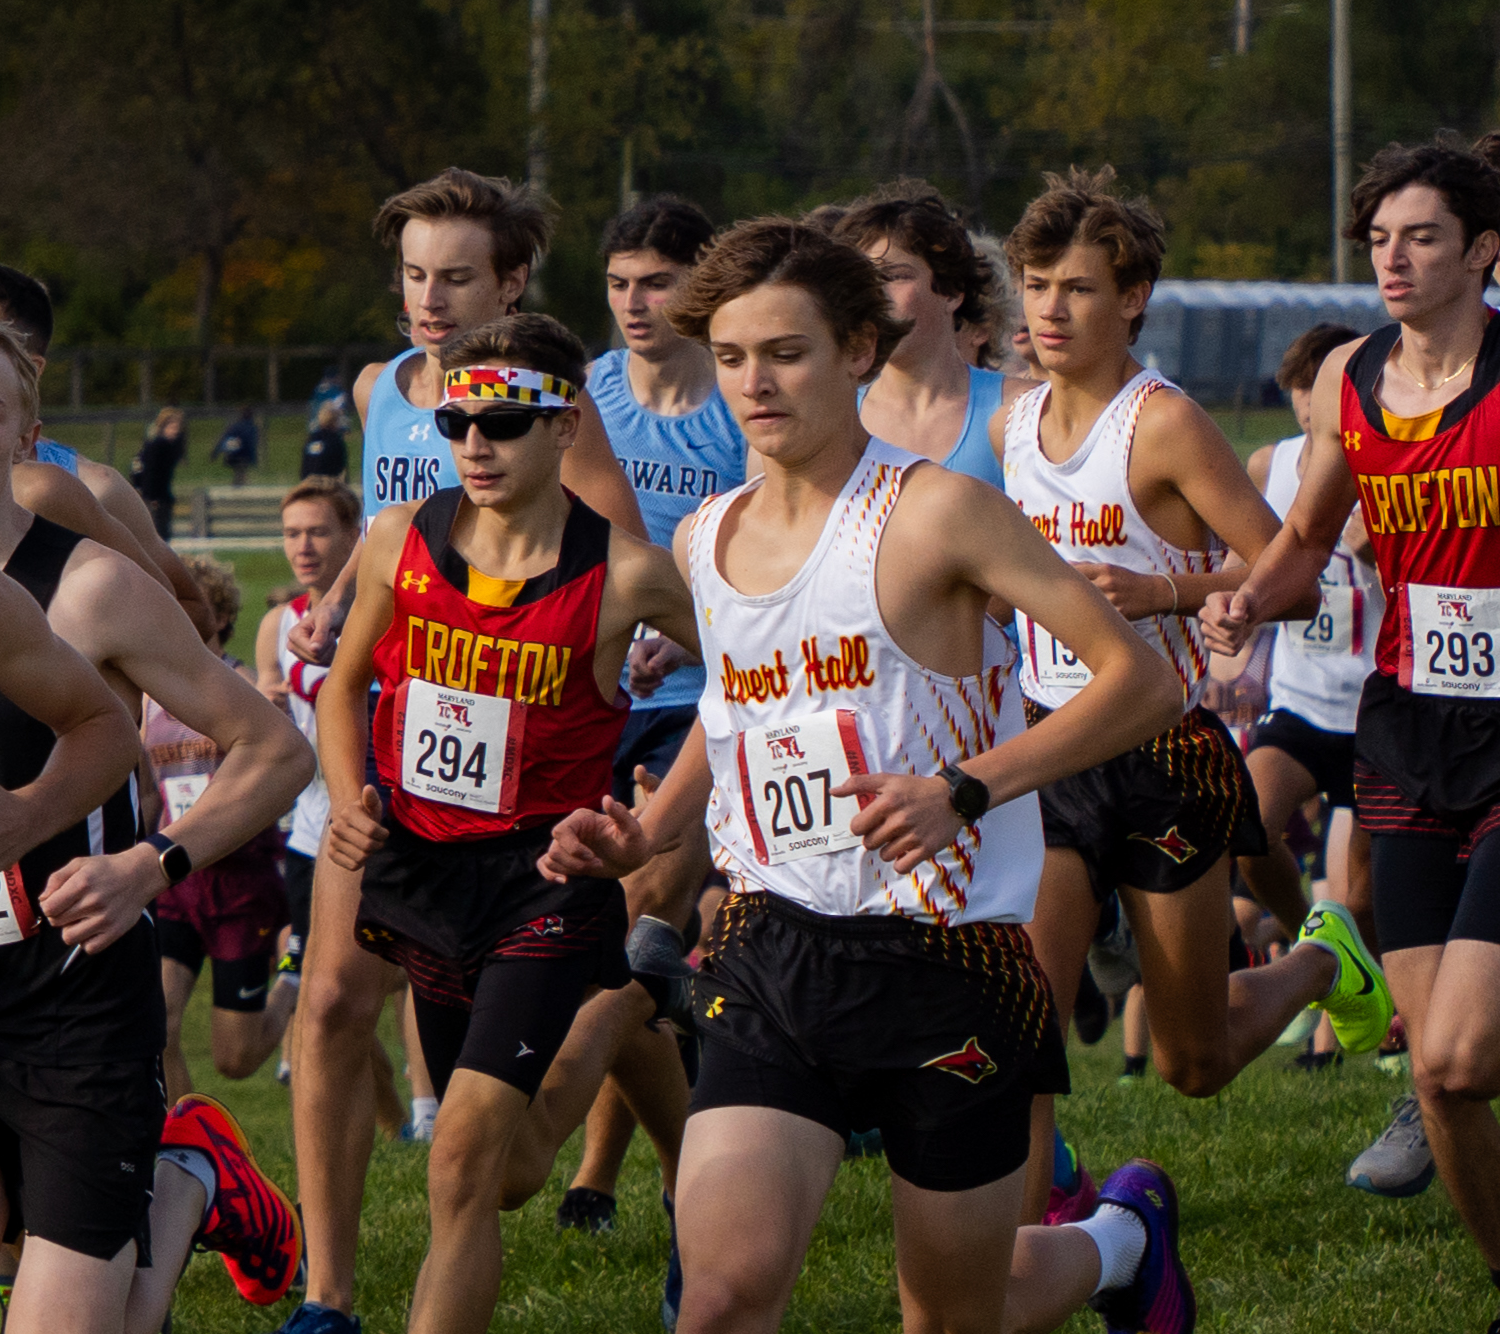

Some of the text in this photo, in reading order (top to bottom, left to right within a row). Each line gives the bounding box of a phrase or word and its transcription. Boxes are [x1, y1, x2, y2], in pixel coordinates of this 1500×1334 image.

[375, 455, 441, 502] SRHS
[618, 457, 719, 499] WARD
[1358, 465, 1500, 534] CROFTON
[1069, 500, 1128, 548] Hall
[406, 615, 572, 707] CROFTON
[801, 634, 876, 698] Hall
[1426, 629, 1496, 678] 293
[1441, 680, 1481, 692] saucony
[415, 728, 488, 789] 294
[425, 783, 467, 800] saucony
[763, 768, 832, 838] 207
[788, 835, 830, 852] saucony
[4, 868, 23, 906] MDXC
